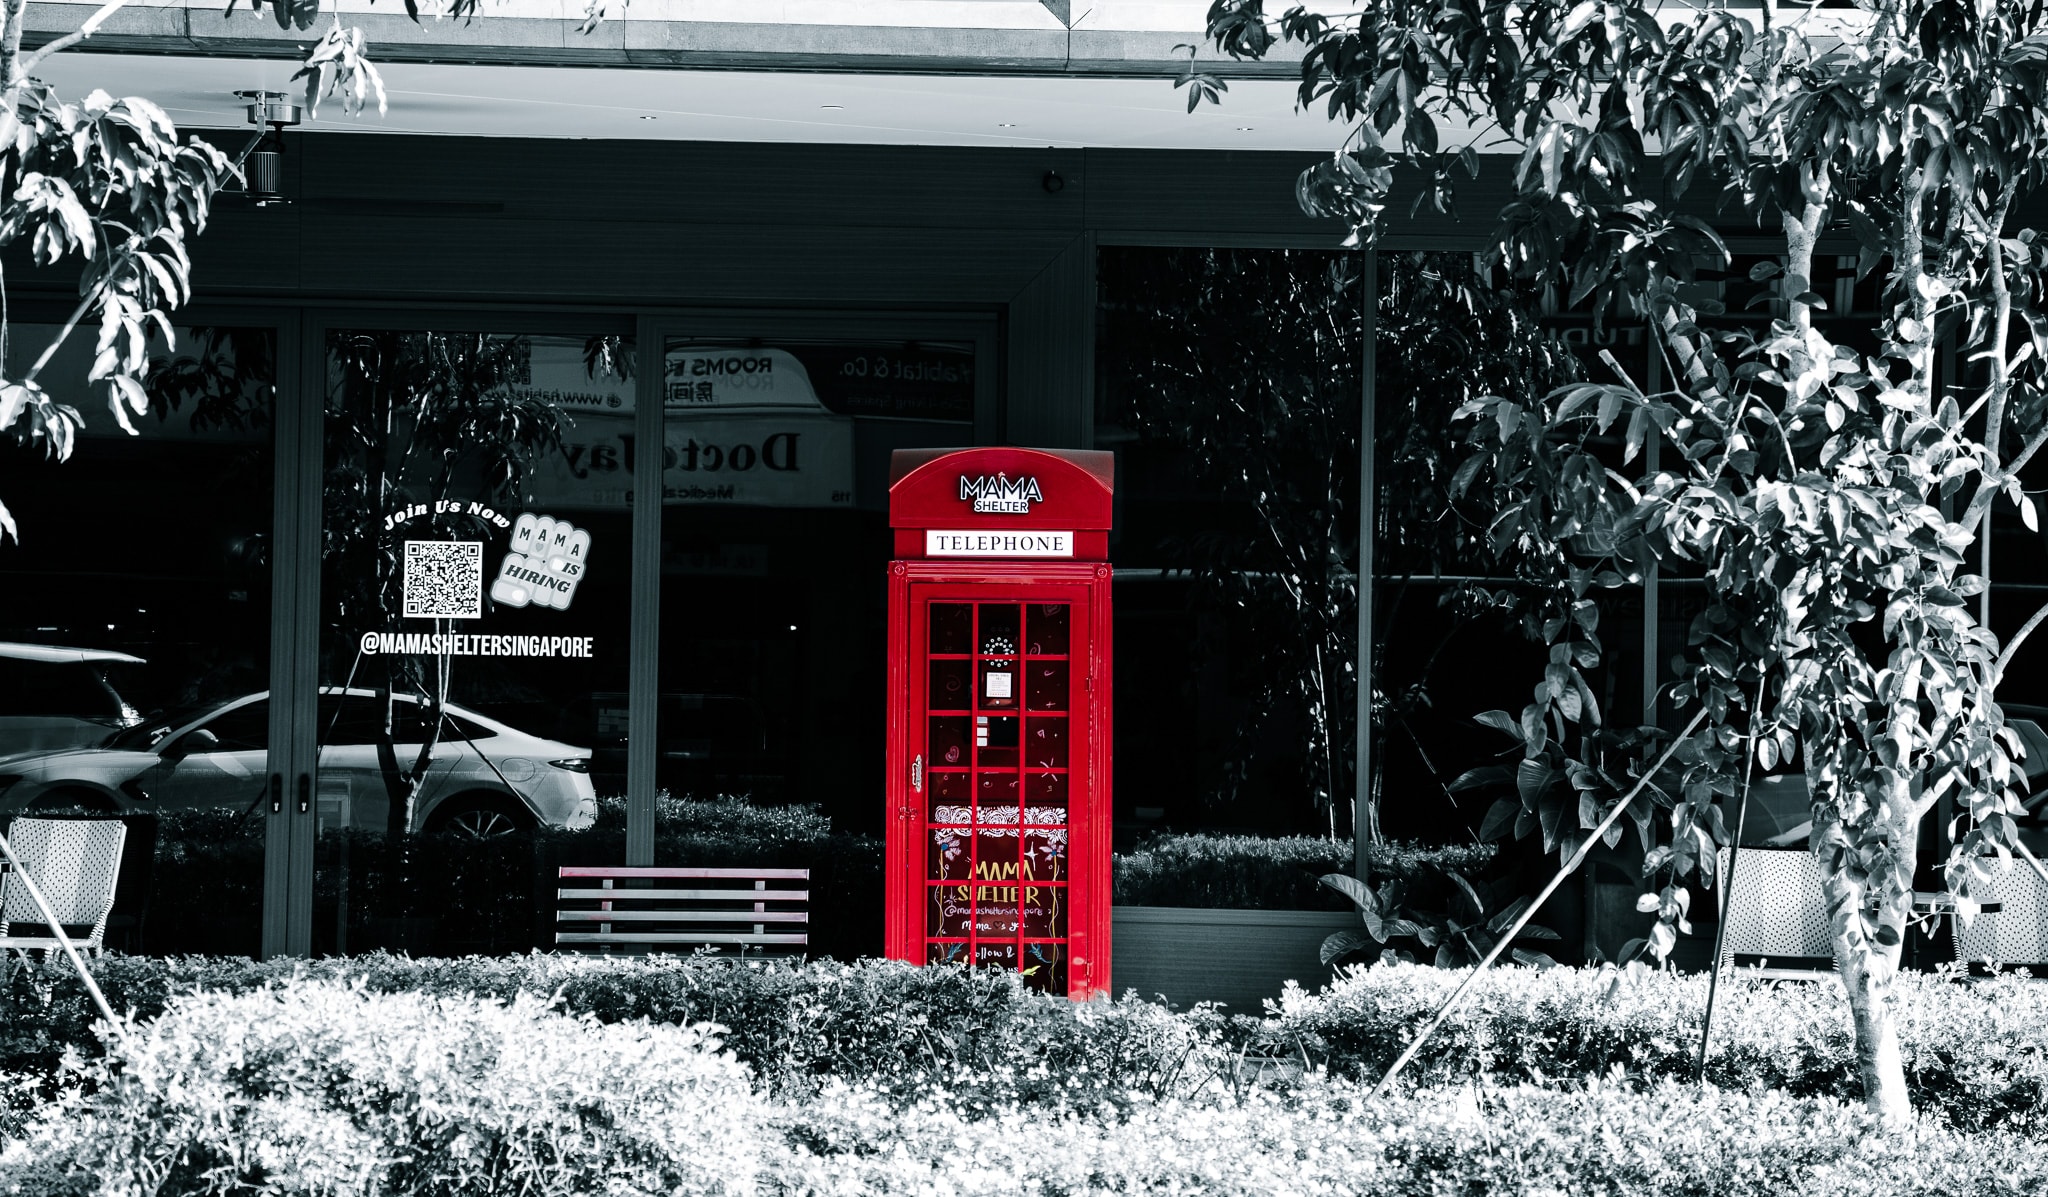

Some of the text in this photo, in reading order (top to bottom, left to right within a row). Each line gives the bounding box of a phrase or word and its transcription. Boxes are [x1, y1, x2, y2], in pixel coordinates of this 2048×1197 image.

[960, 475, 1043, 502] MAMA
[384, 499, 511, 531] Join Us Now
[974, 500, 1029, 513] SHELTER
[518, 526, 580, 557] MAMA
[936, 535, 1065, 552] TELEPHONE
[504, 564, 571, 594] HIRING
[561, 562, 581, 576] IS
[360, 631, 594, 658] @MAMASHELTERSINGAPORE
[967, 859, 1035, 882] MAMA
[956, 884, 1041, 907] SHELTER
[961, 920, 992, 932] Mma
[970, 946, 1003, 960] ollow
